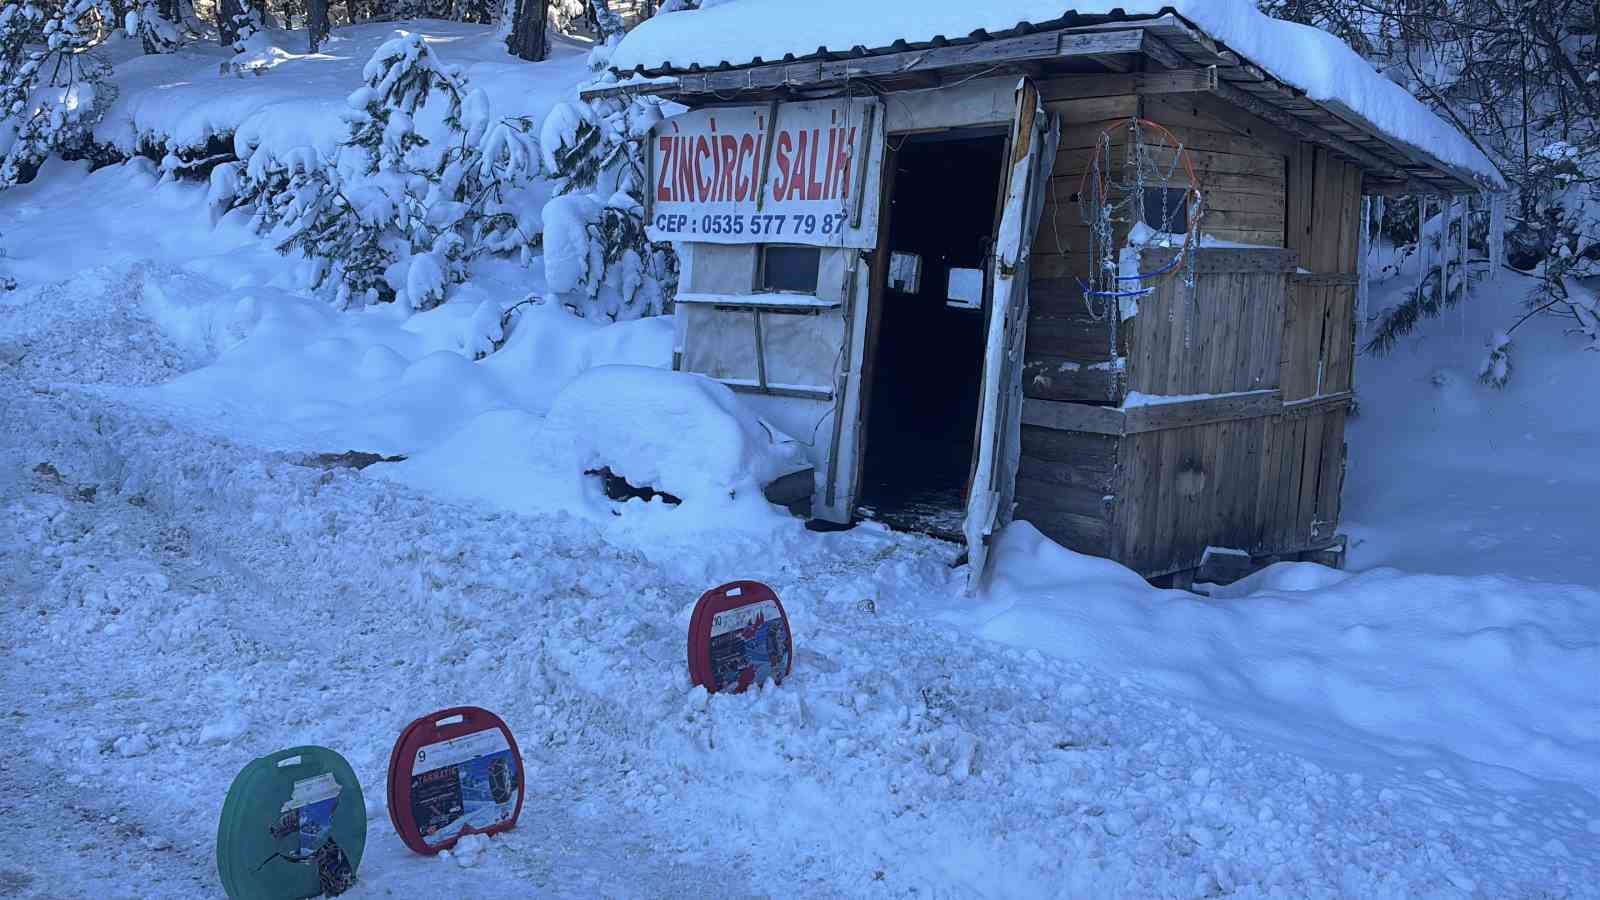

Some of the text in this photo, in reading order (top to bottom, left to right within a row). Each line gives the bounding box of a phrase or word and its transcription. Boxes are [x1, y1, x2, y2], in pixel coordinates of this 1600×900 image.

[657, 115, 764, 203] ZİNCİRCİ
[656, 213, 688, 233] CEP
[702, 214, 744, 234] 0535
[750, 214, 786, 235] 577
[793, 214, 816, 235] 79
[821, 214, 846, 235] 87
[418, 750, 426, 763] 9
